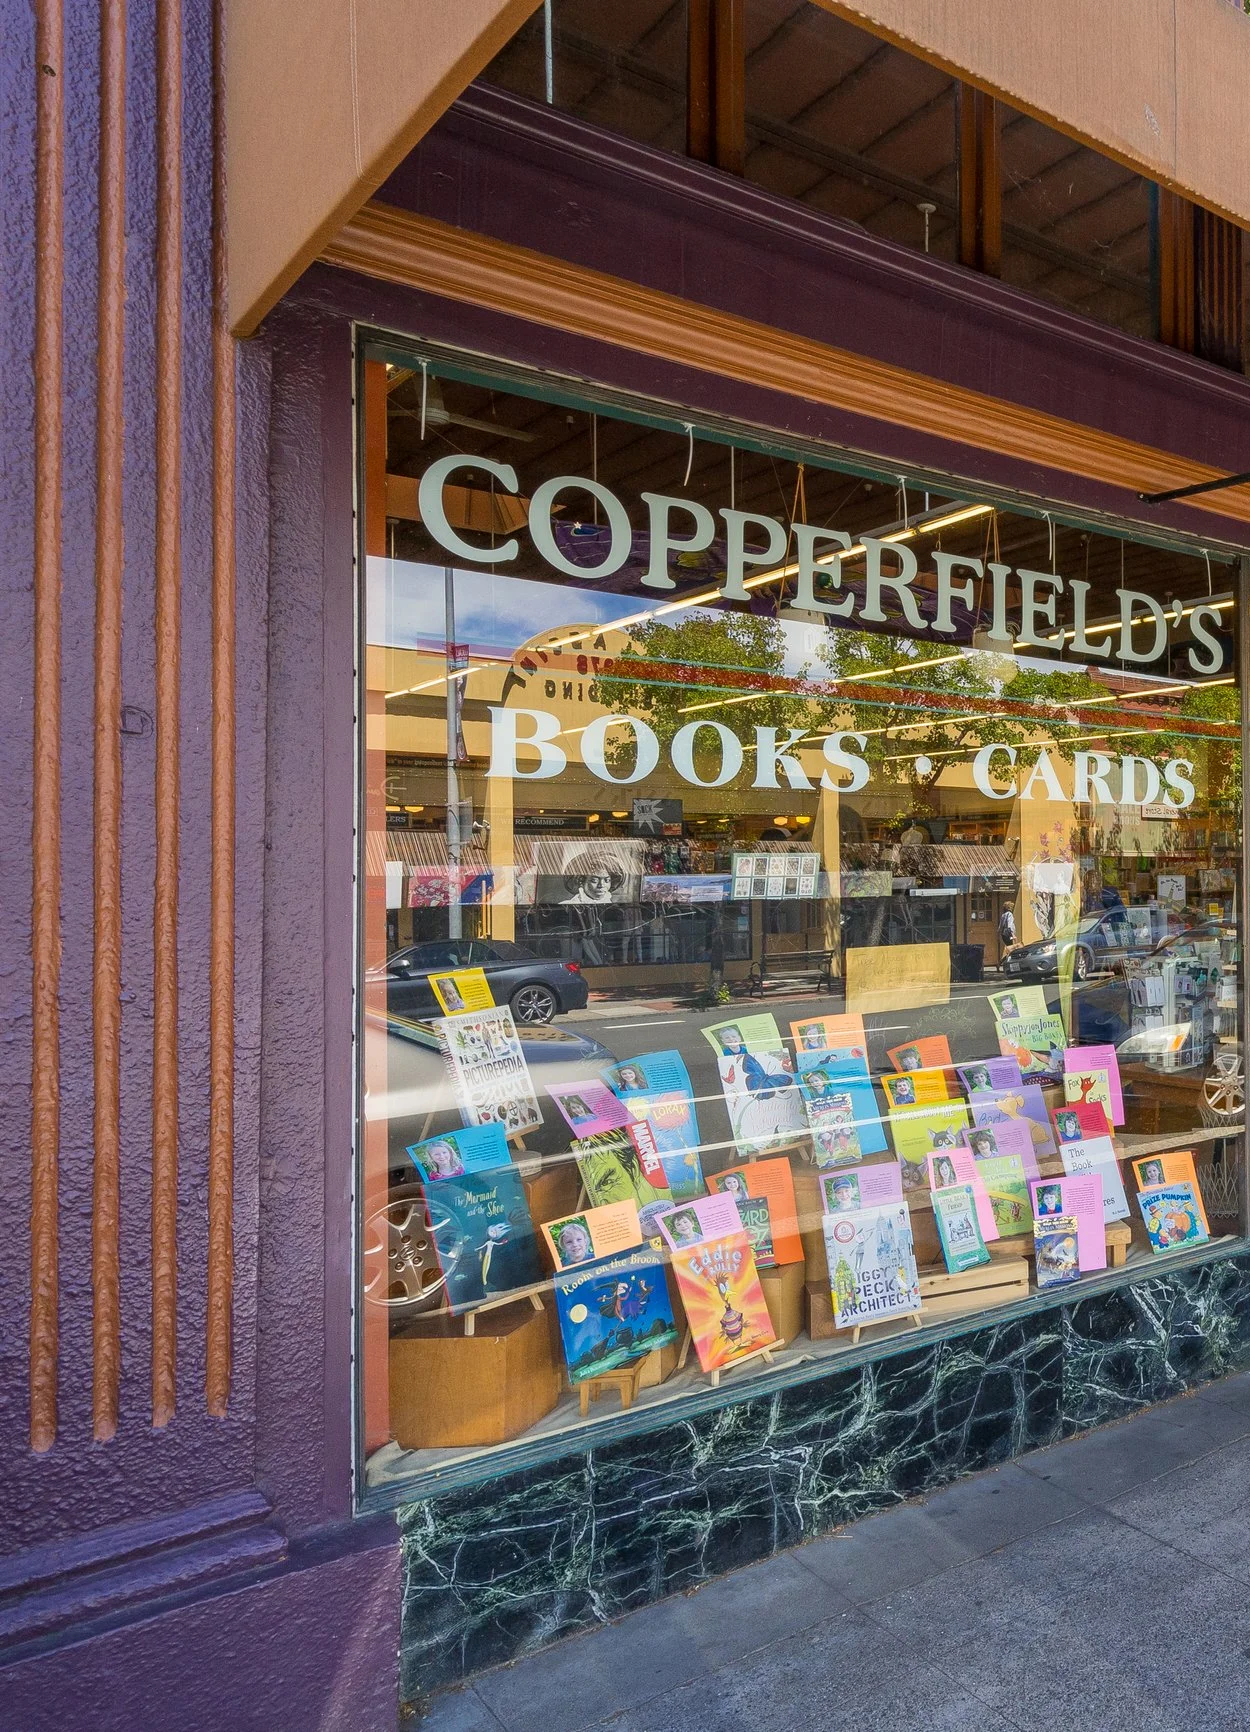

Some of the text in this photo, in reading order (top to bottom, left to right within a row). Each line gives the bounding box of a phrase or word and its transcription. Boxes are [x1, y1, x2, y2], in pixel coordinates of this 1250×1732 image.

[418, 453, 1224, 674] COPPERFIELD'S
[485, 706, 1196, 809] BOOKS CARDS
[1040, 1018, 1060, 1033] Jones
[1032, 1034, 1043, 1043] BIG
[463, 1054, 525, 1087] PICTUREPEDIA
[1067, 1079, 1080, 1091] Fox
[652, 1104, 686, 1121] LORAX
[632, 1122, 660, 1175] MARVEL
[1068, 1148, 1085, 1159] The
[1072, 1161, 1093, 1172] Book
[454, 1186, 498, 1207] The Mermaid
[1142, 1193, 1192, 1210] PRIZE PUMPKIN
[467, 1200, 505, 1217] and the Shoe
[688, 1245, 743, 1276] Eddie
[709, 1261, 740, 1275] BULLY
[561, 1253, 661, 1297] Room on the Broom
[856, 1266, 889, 1283] IGGY
[841, 1290, 912, 1318] ARCHITECT
